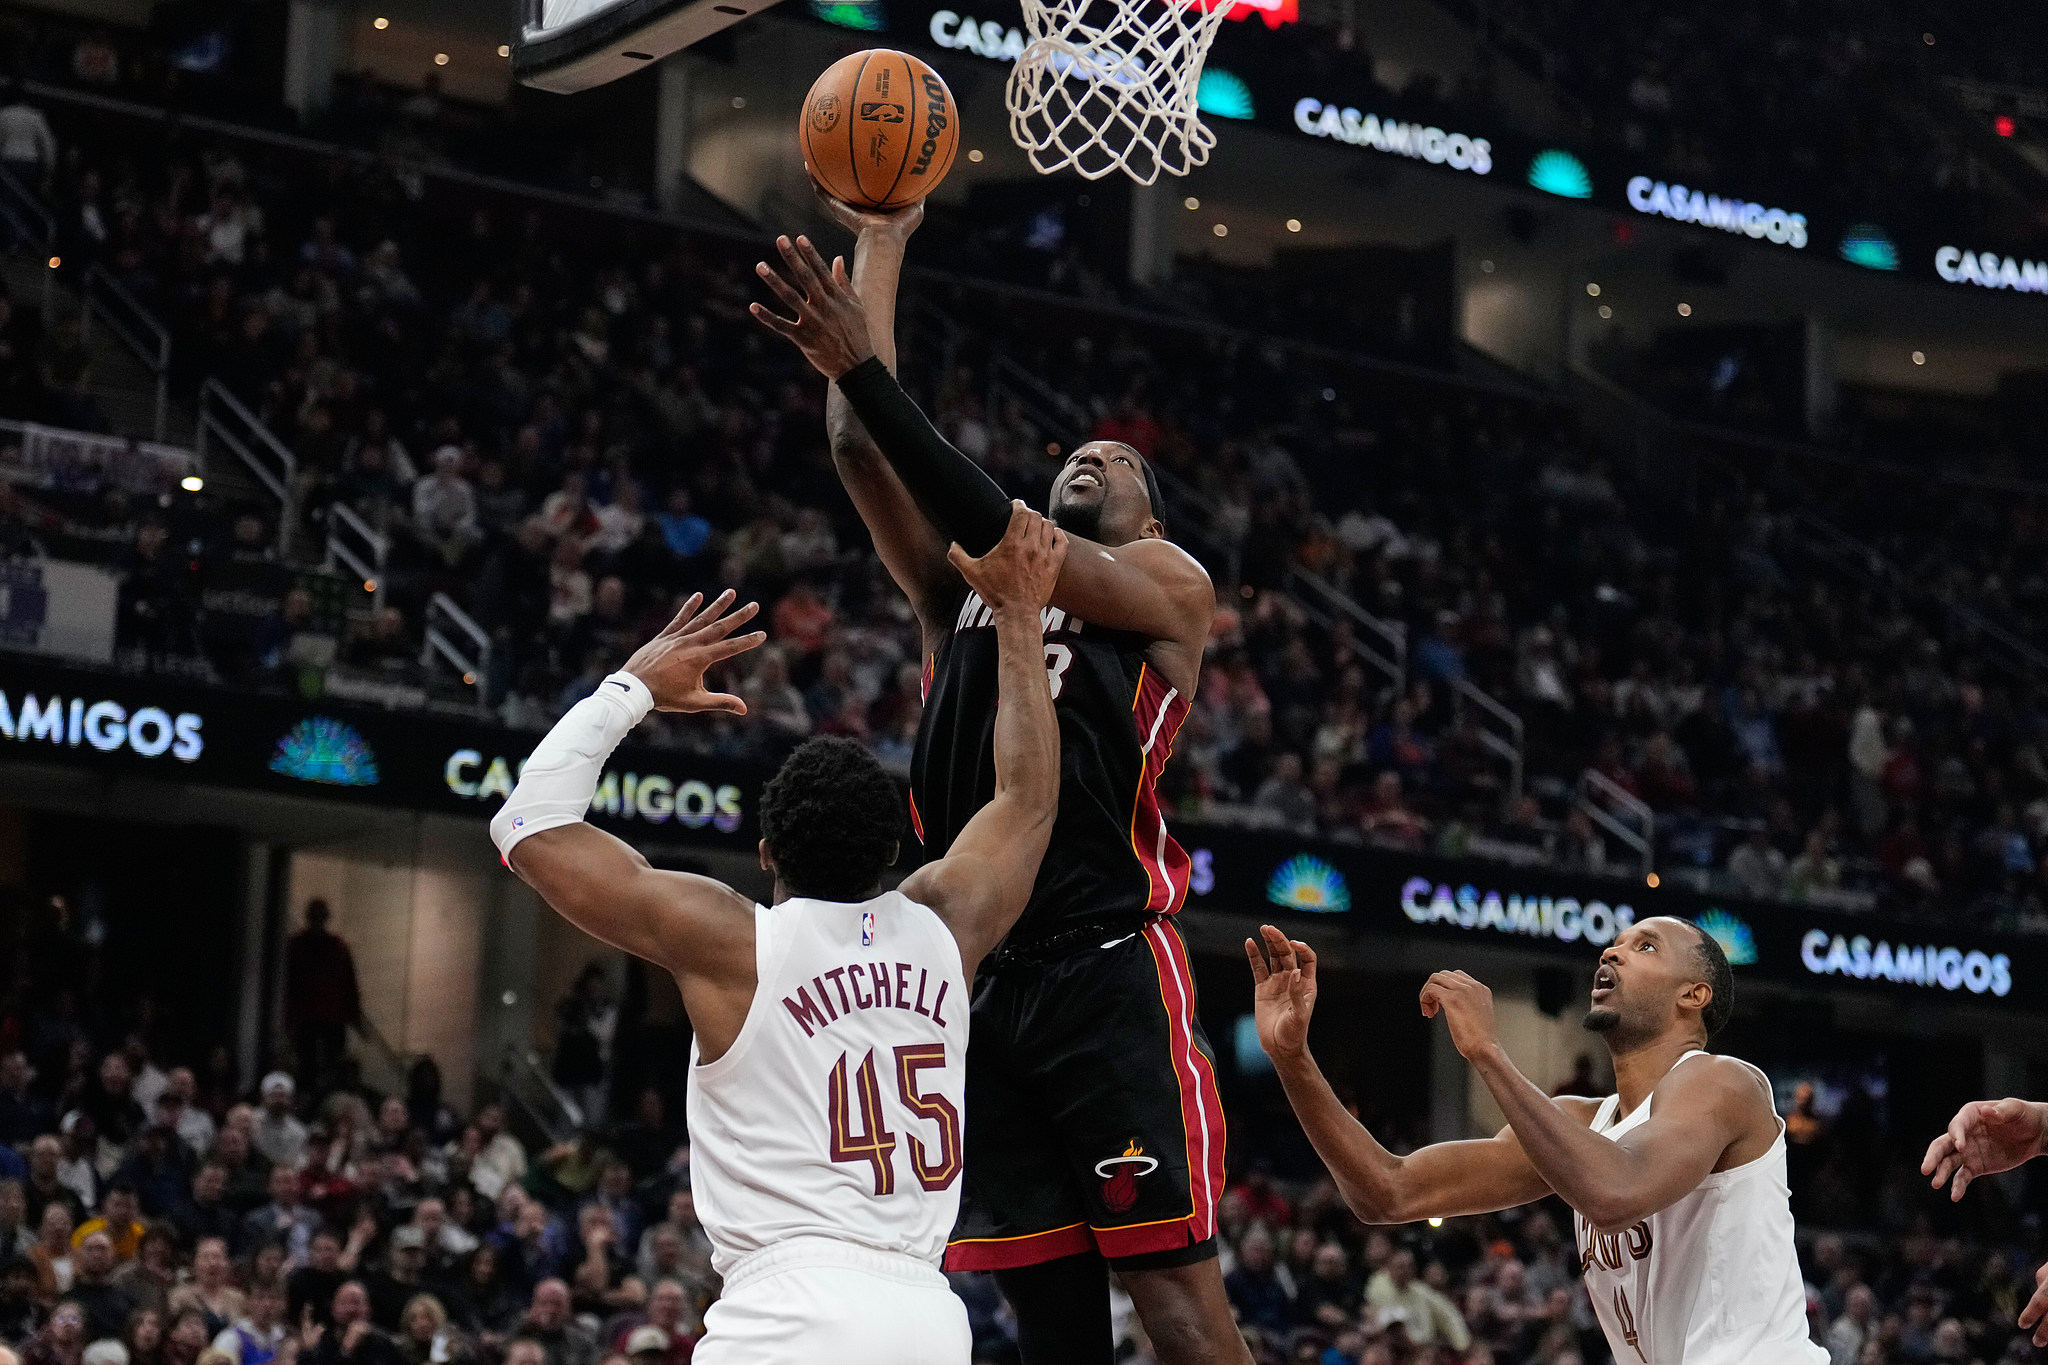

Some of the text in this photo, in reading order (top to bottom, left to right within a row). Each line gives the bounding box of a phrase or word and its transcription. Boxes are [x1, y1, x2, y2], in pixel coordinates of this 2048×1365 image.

[909, 74, 947, 175] Wilson
[1294, 97, 1492, 175] CASAMIGOS
[1627, 175, 1808, 248] CASAMIGOS
[445, 749, 743, 833] CAMIGOS
[1401, 876, 1636, 947] CASAMIGOS
[782, 962, 948, 1038] MITCHELL
[1801, 929, 2012, 996] CASAMIGOS
[829, 1043, 962, 1196] 45
[1614, 1285, 1647, 1363] 4
